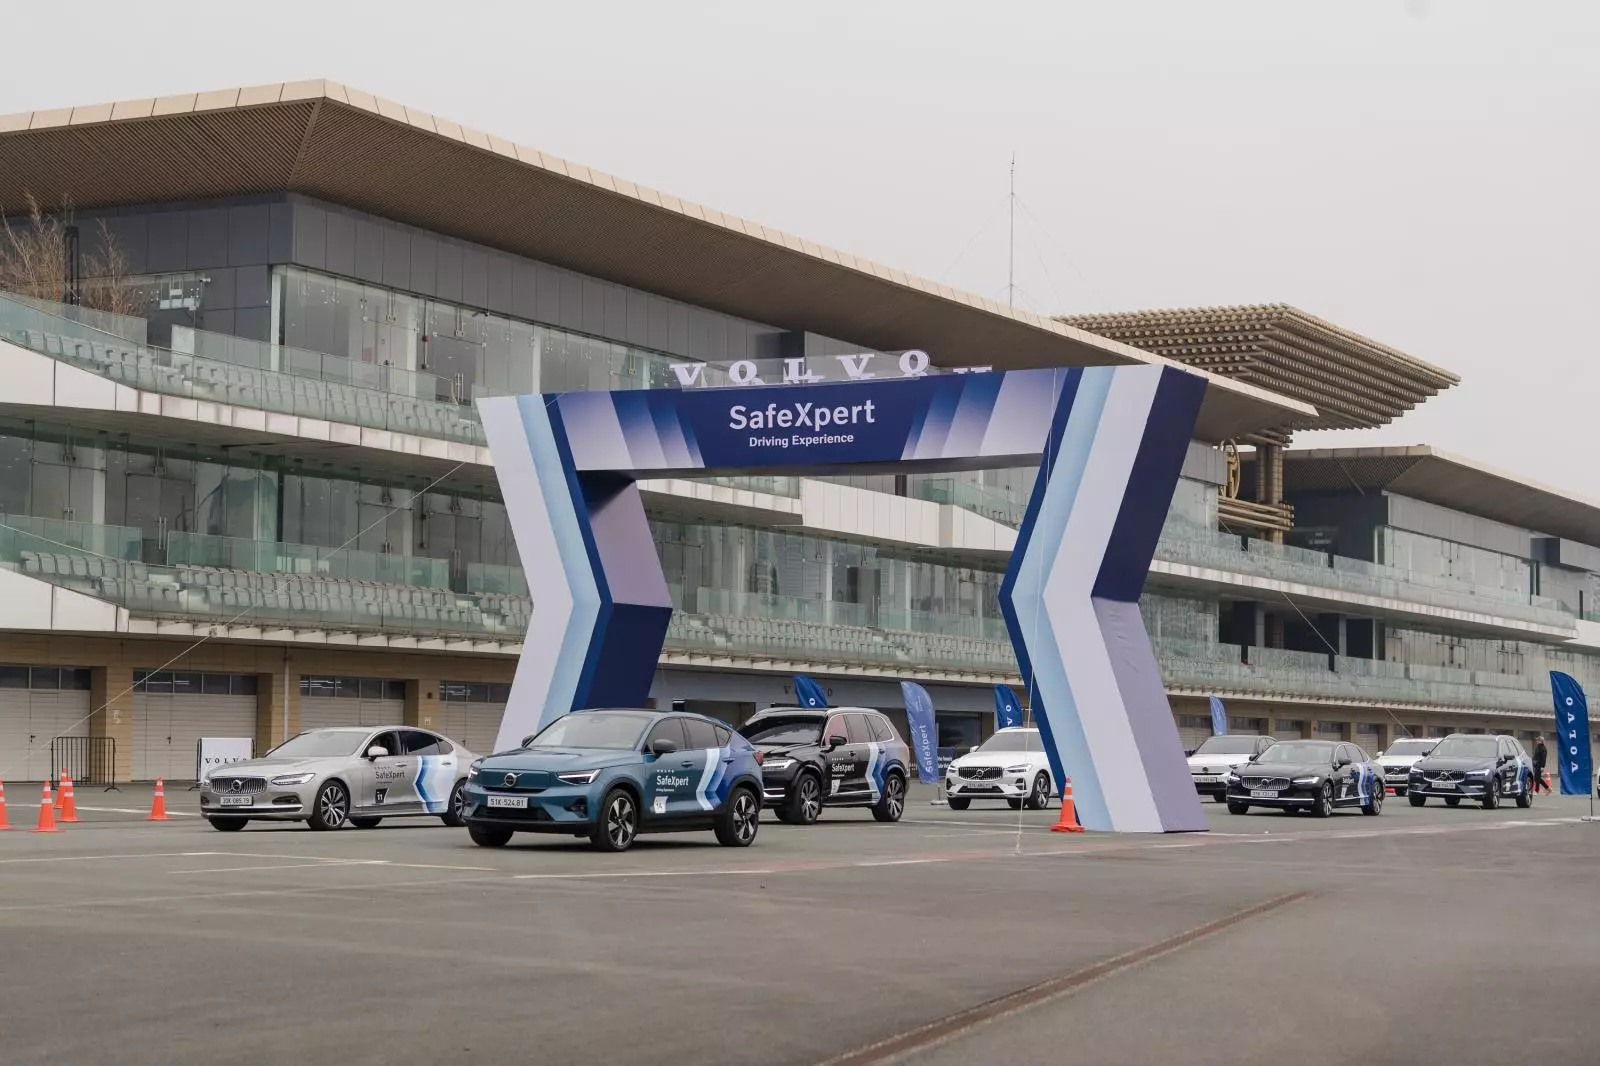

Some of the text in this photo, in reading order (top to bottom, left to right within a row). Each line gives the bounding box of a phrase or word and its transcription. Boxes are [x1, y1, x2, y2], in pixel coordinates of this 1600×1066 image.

[670, 350, 930, 385] VOLVO
[729, 400, 876, 431] SafeXpert
[749, 433, 854, 449] Driving Experience
[1565, 696, 1579, 773] VOLVO
[376, 771, 405, 780] SafeXpert
[656, 775, 689, 788] SafeXpert
